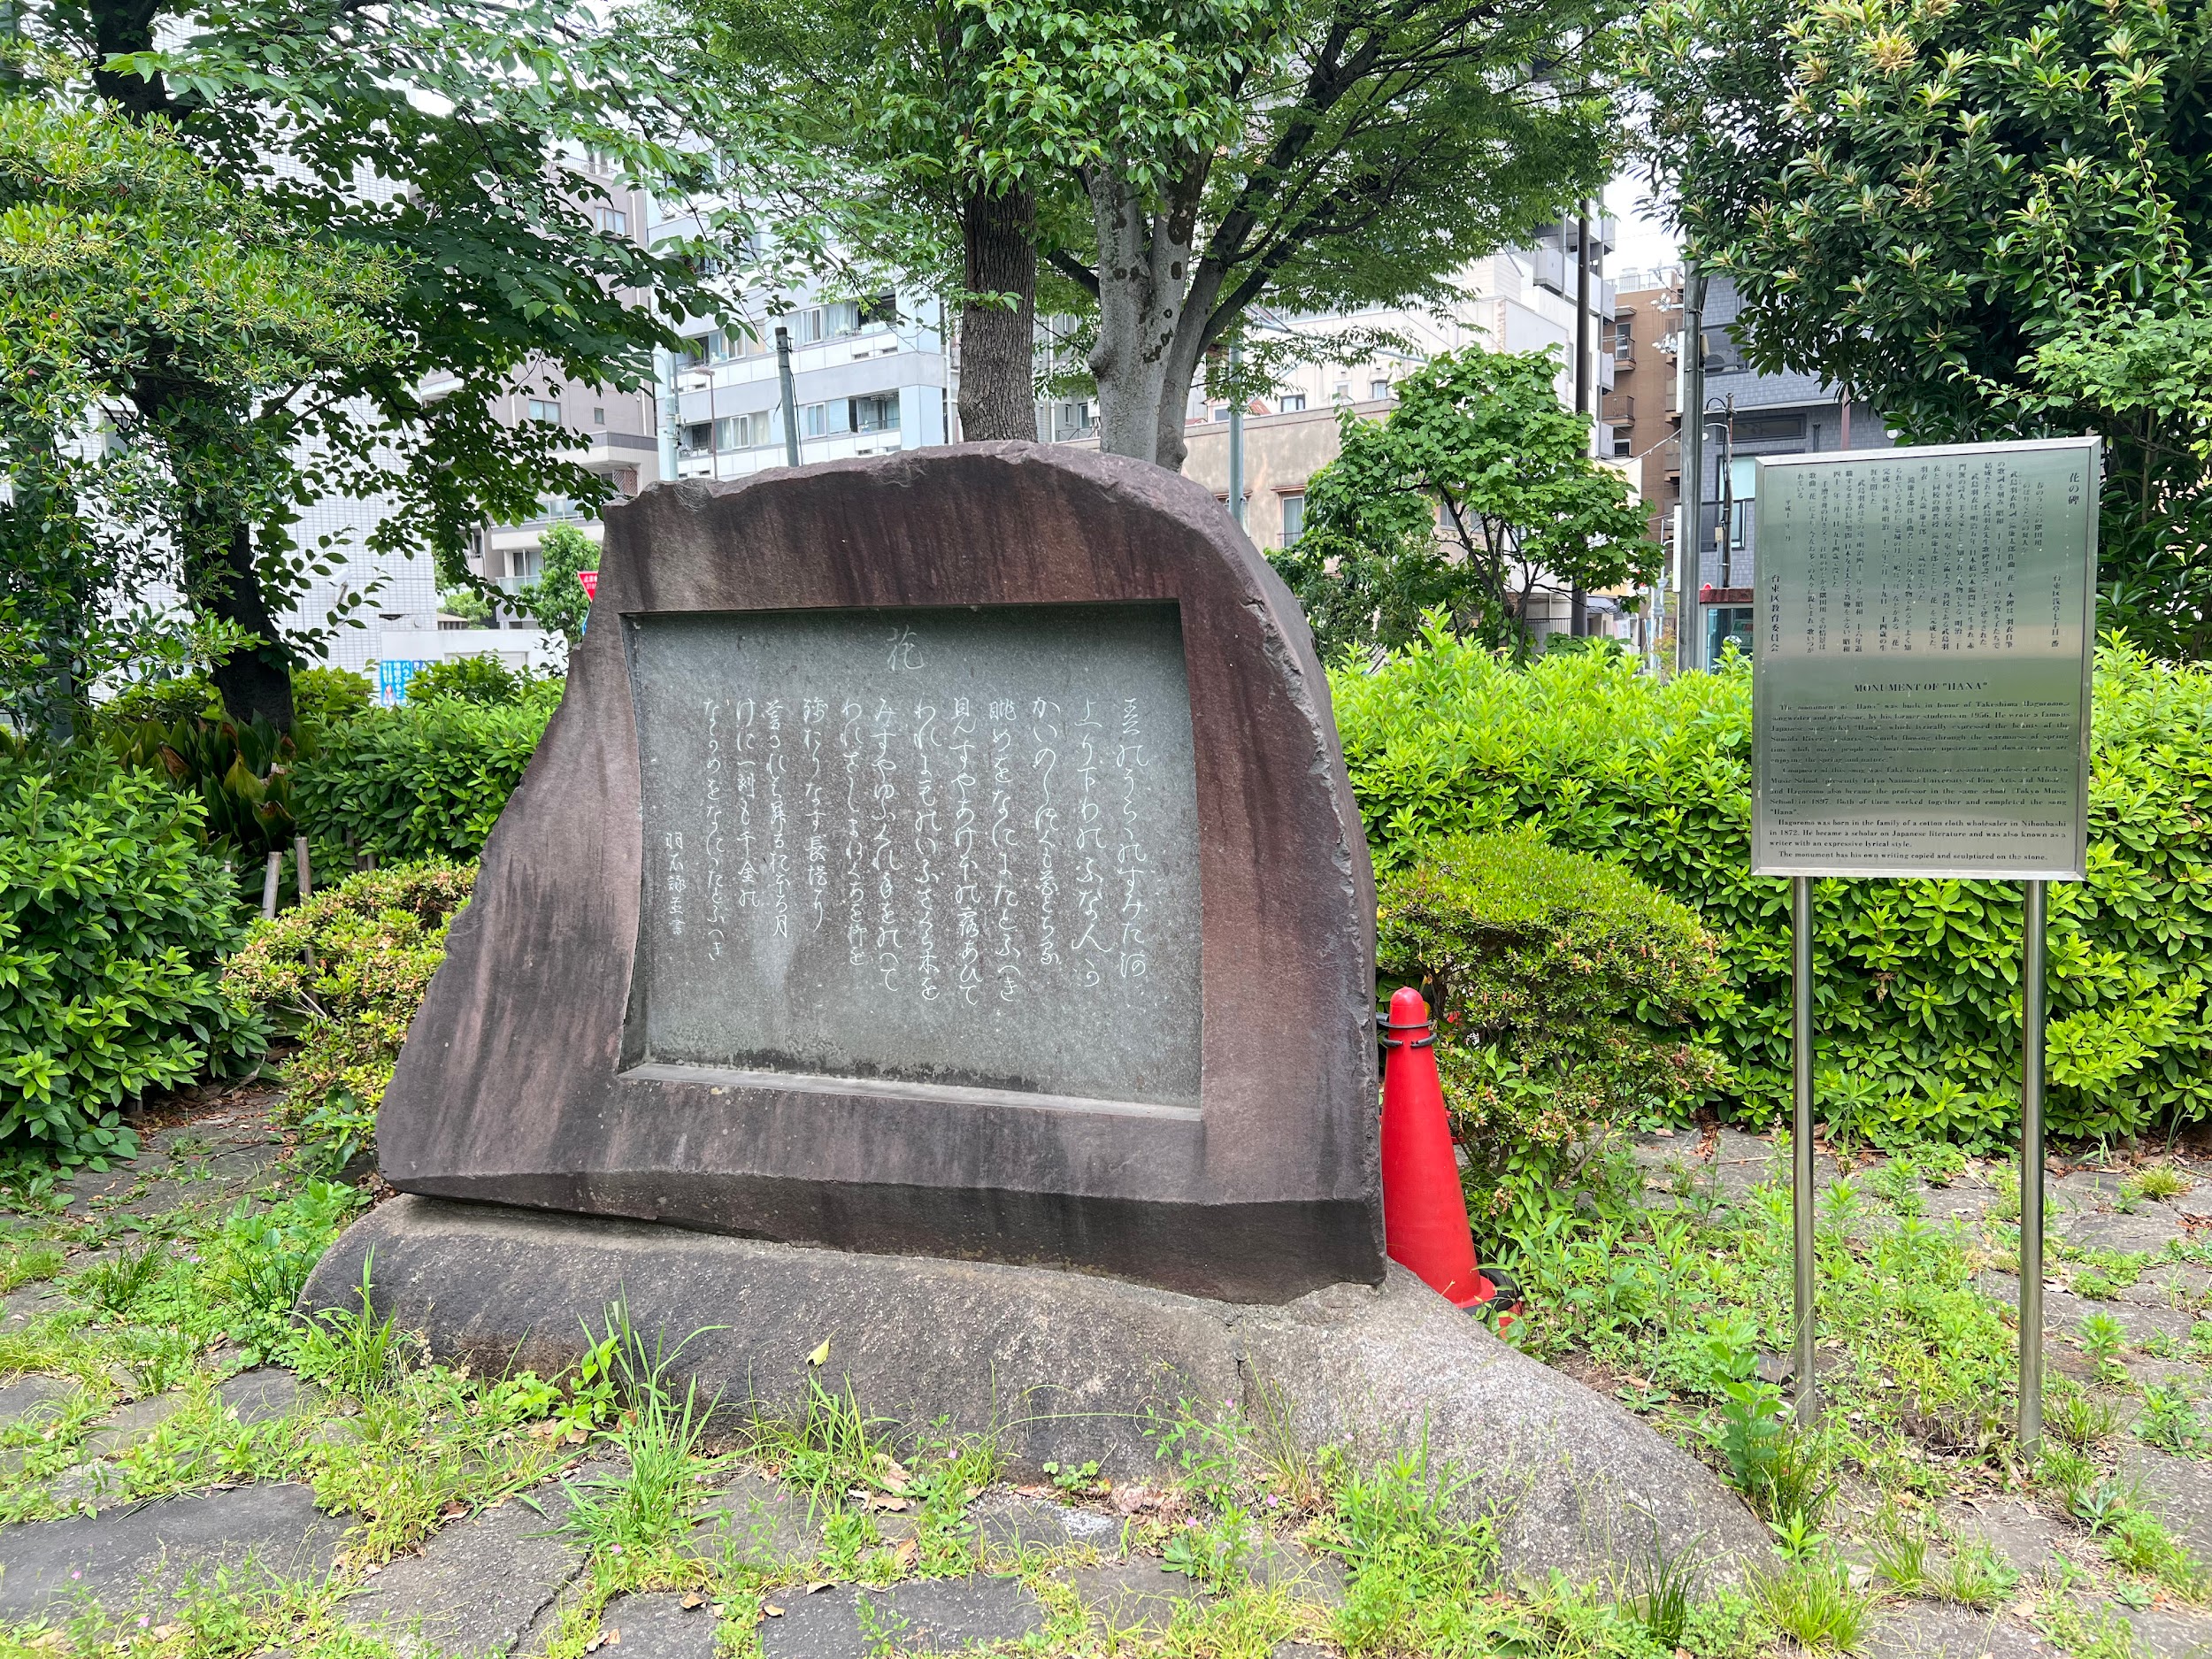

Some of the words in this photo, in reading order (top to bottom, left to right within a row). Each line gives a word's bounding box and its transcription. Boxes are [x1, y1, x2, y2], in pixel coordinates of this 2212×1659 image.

[2068, 472, 2080, 505] 花の碑
[1770, 574, 1780, 653] 台東区教育委員会
[886, 626, 926, 672] 花
[1854, 683, 1921, 693] MONUMENT
[1924, 682, 1939, 692] OF
[1943, 681, 1989, 691] "HANA"
[1877, 819, 1900, 828] family
[1824, 840, 1863, 849] expressive
[1910, 852, 1935, 861] copied
